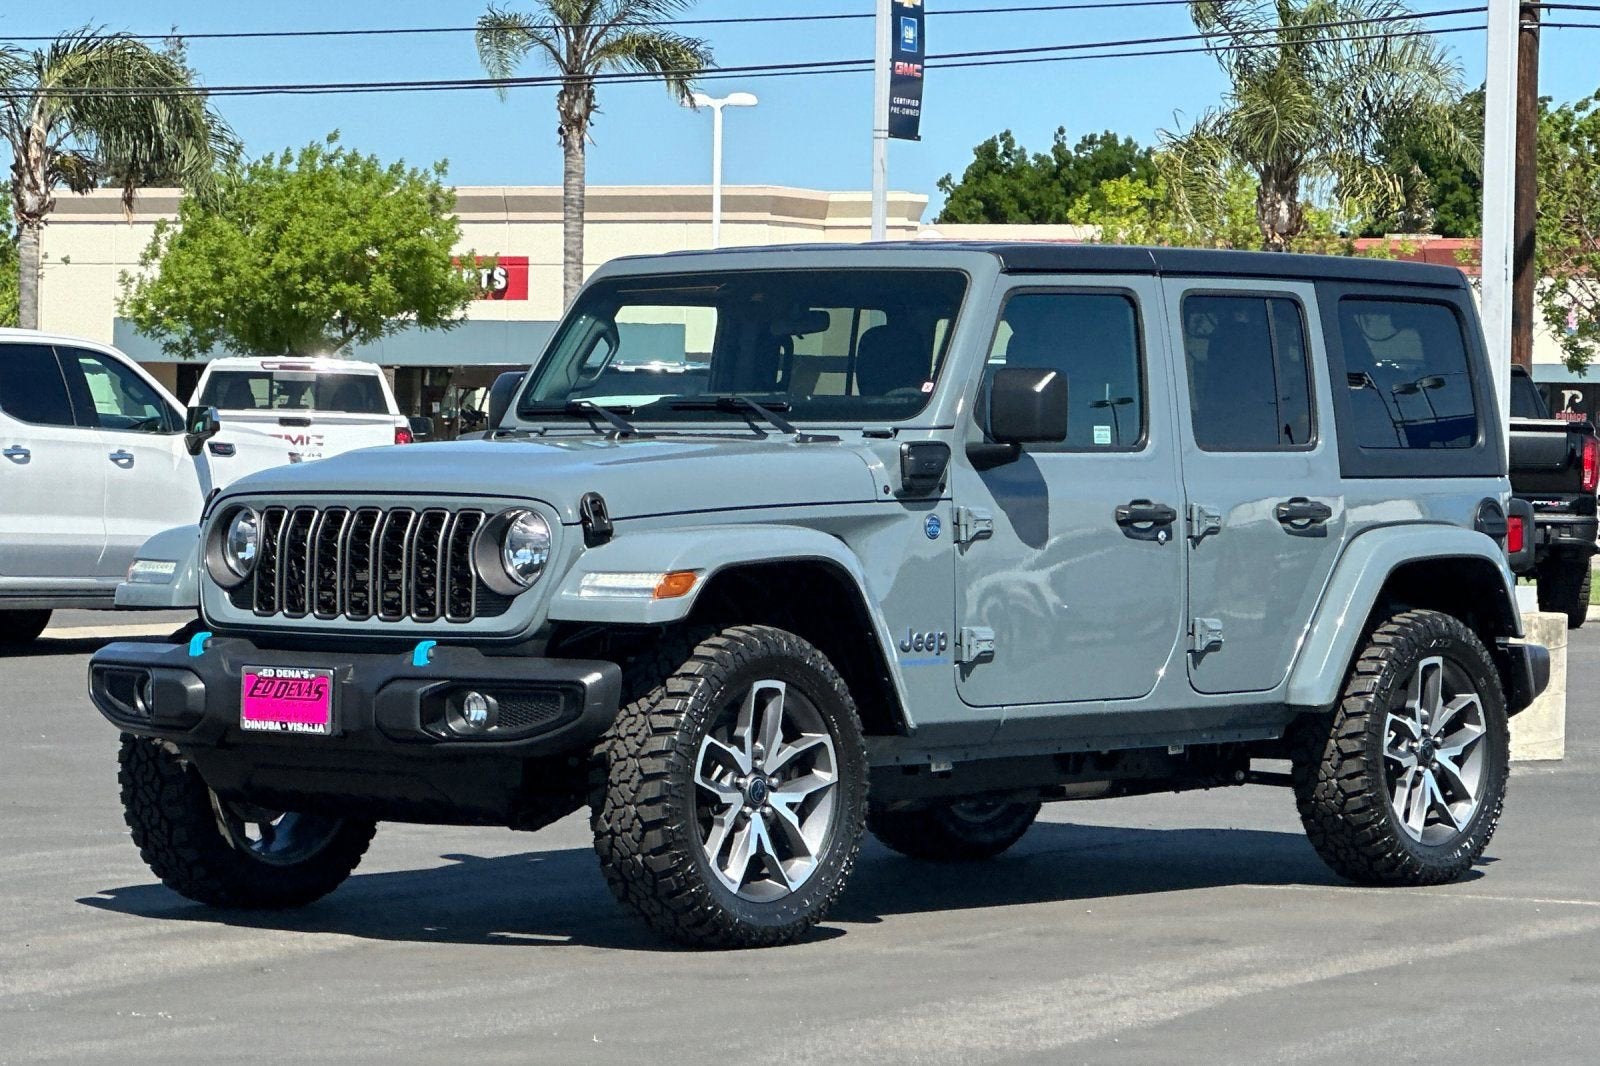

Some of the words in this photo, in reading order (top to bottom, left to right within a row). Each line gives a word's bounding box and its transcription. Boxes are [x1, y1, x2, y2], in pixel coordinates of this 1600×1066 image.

[894, 61, 922, 78] GMC
[893, 97, 919, 107] CERTIFIED
[890, 106, 919, 117] PRE-OWNED
[1555, 412, 1587, 422] PRIMOS
[899, 625, 948, 656] Jeep
[262, 669, 274, 678] ED
[248, 680, 275, 697] ED
[244, 720, 281, 730] DINUBA
[287, 722, 325, 733] VISALIA
